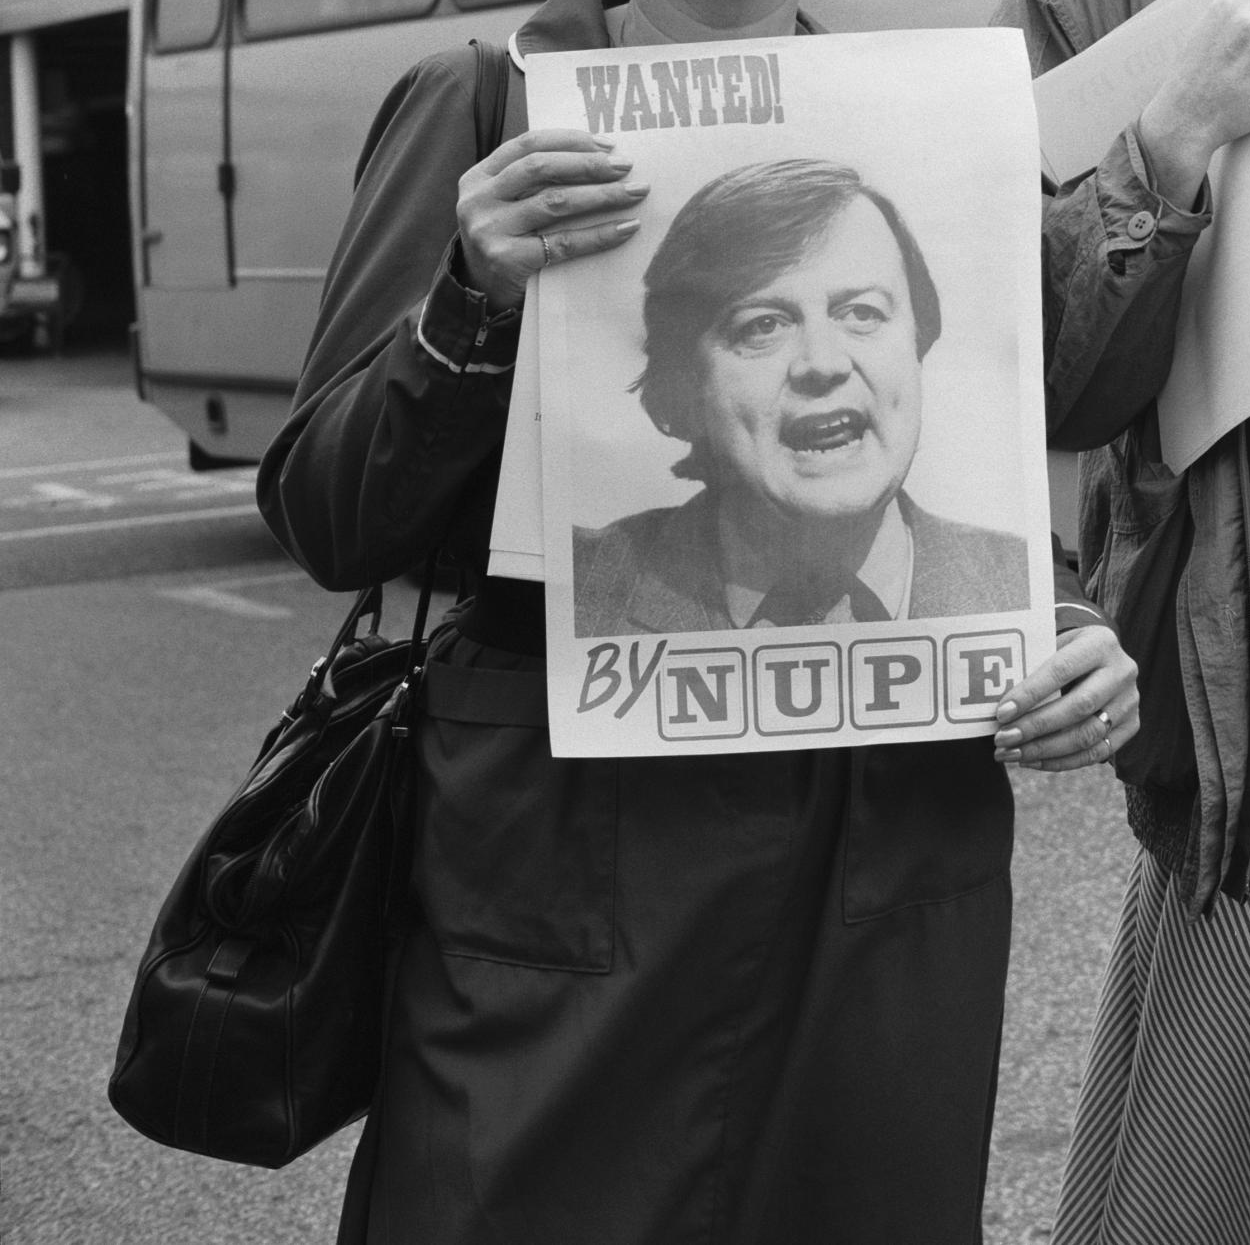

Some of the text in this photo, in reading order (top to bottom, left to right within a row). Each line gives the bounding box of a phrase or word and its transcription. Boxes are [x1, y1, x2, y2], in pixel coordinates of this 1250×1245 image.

[576, 53, 785, 134] WANTED!
[576, 639, 1014, 724] BY NUPE
